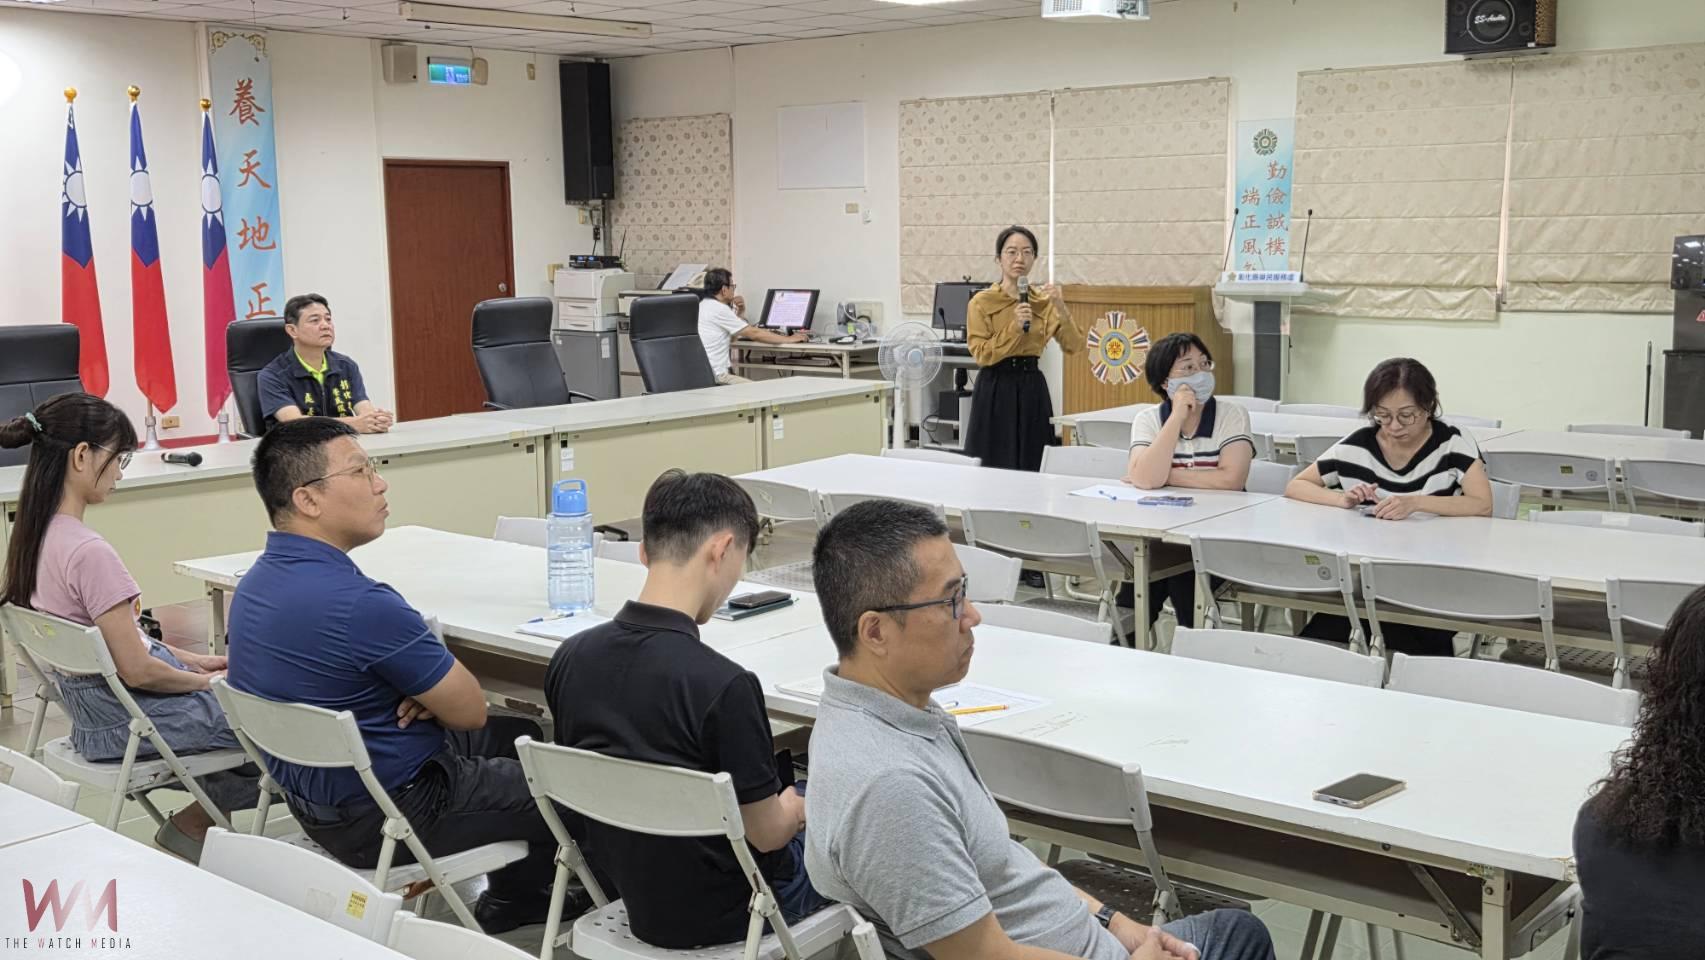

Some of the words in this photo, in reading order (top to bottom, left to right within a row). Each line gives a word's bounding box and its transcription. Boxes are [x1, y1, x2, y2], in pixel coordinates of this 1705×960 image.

[229, 77, 277, 319] 養天地正
[1264, 160, 1289, 256] 勤儉誠樸
